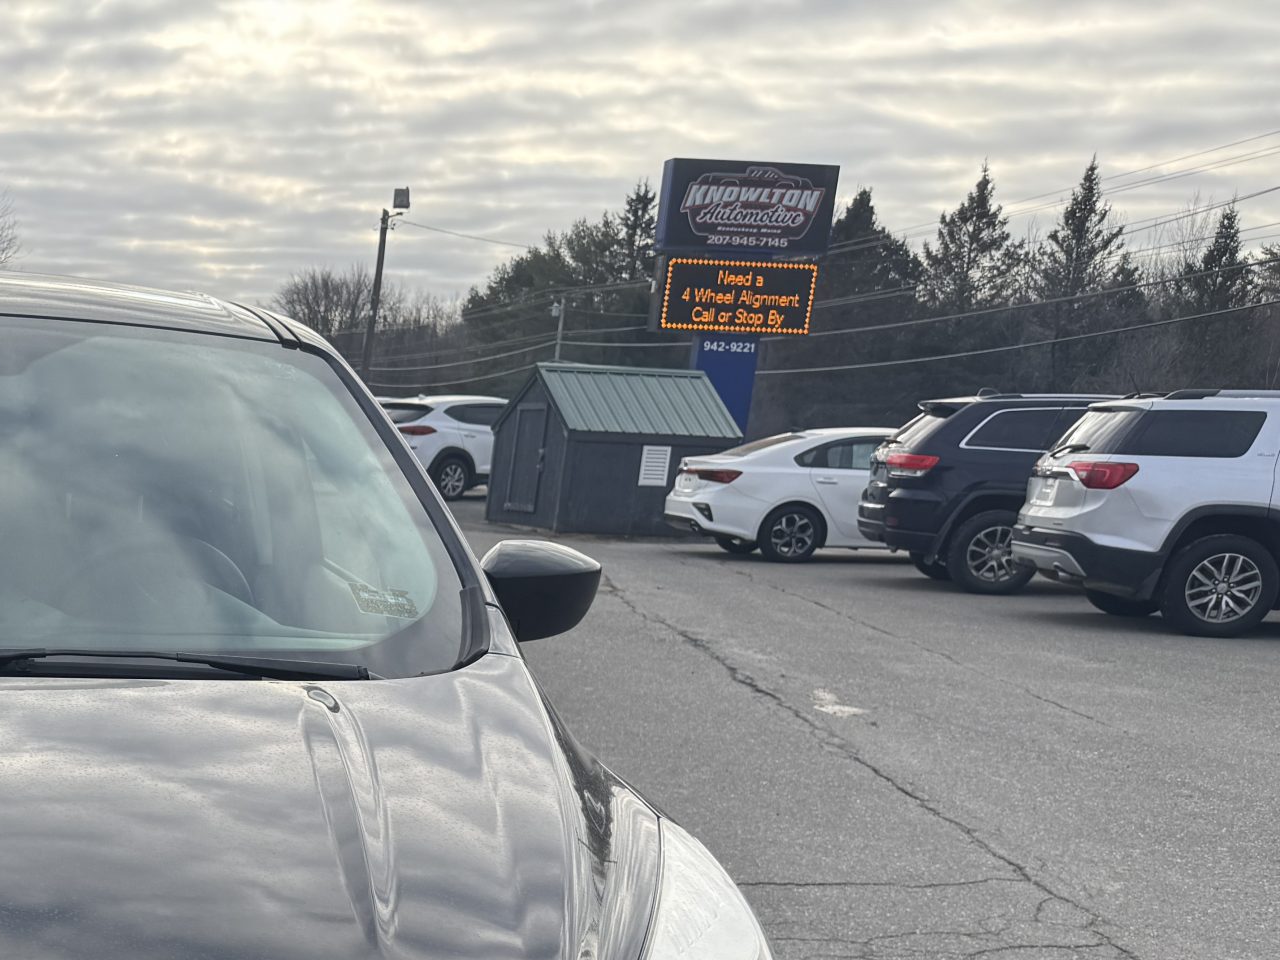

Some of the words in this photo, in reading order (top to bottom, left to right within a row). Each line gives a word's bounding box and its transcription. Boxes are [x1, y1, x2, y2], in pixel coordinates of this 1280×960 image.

[685, 185, 821, 212] KNOWLTON
[696, 202, 804, 227] Automotive
[706, 234, 788, 248] 207-945-7145
[718, 270, 753, 287] Need
[756, 275, 764, 287] a
[681, 287, 691, 302] 4
[694, 287, 736, 305] Wheel
[738, 290, 800, 309] Alignment
[691, 306, 715, 323] Call
[717, 311, 732, 323] or
[735, 308, 764, 327] Stop
[767, 310, 785, 328] By
[703, 341, 756, 353] 942-9221
